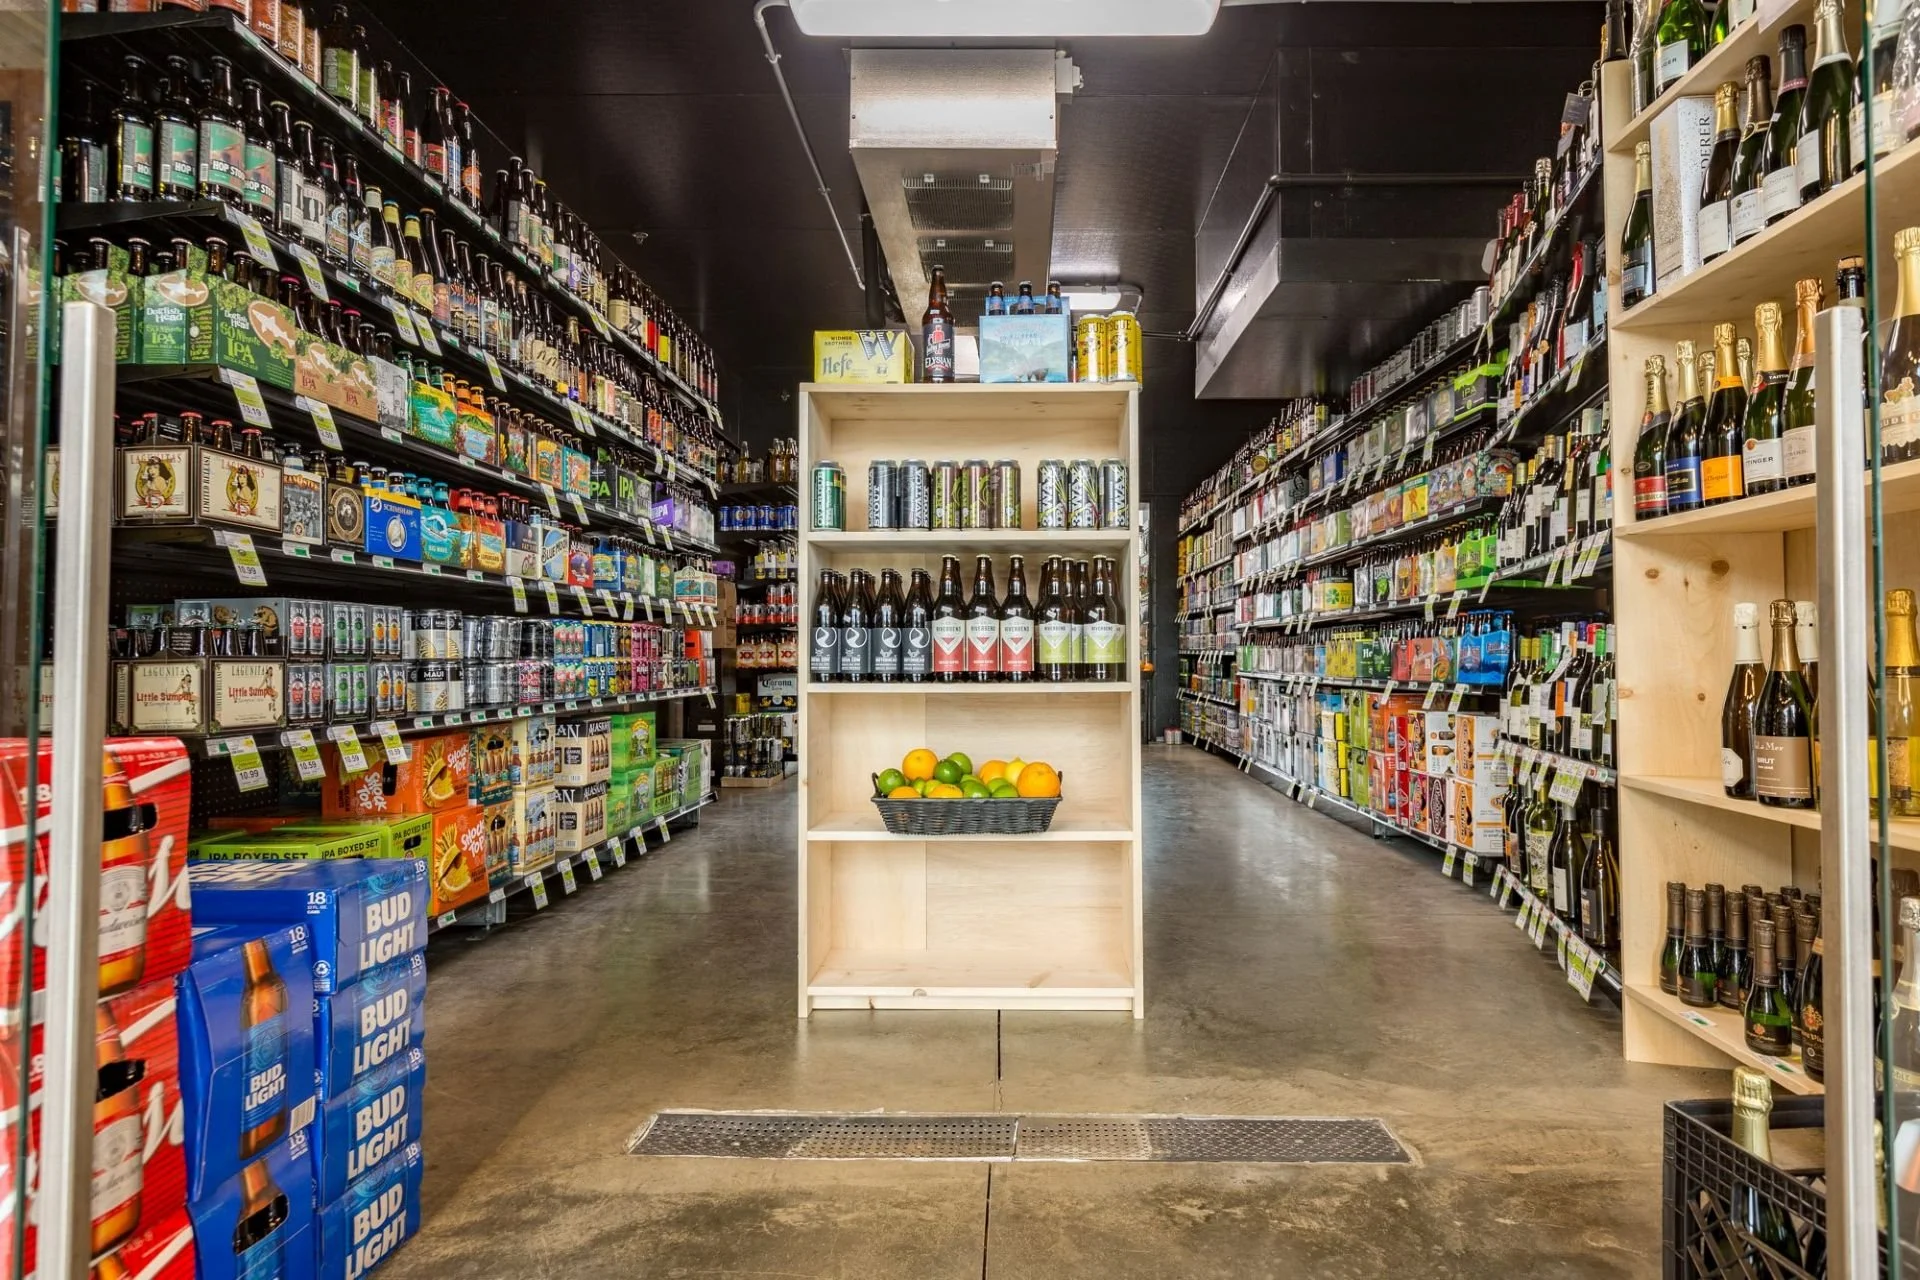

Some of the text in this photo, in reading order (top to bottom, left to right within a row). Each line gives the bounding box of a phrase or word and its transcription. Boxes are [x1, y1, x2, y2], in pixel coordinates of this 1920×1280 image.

[213, 160, 230, 172] HOP
[155, 313, 185, 323] Head
[151, 332, 177, 345] IPA
[227, 337, 256, 364] IPA
[822, 353, 853, 378] Hefe
[924, 356, 952, 369] ELYSIAN
[619, 475, 635, 500] IPA
[915, 468, 923, 527] CAVATICA
[874, 485, 883, 527] STOUT
[143, 666, 191, 678] LAGUNITAS
[228, 686, 248, 698] Little
[762, 678, 792, 689] Corona
[136, 692, 159, 702] Little
[299, 761, 317, 770] 10.59
[447, 743, 469, 766] SHOCK
[239, 769, 259, 780] 10.99
[356, 782, 373, 810] TOP
[364, 772, 387, 812] SHOCK
[337, 841, 364, 857] BOXED
[365, 838, 380, 850] SET
[414, 860, 427, 873] 18
[306, 891, 327, 906] 18
[366, 891, 412, 935] BUD
[287, 926, 306, 944] 18
[360, 921, 416, 971] LIGHT
[410, 953, 422, 969] 18
[361, 988, 408, 1038] BUD
[354, 1018, 412, 1076] LIGHT
[408, 1049, 421, 1064] 18
[249, 1063, 284, 1093] BUD
[245, 1074, 287, 1112] LIGHT
[355, 1085, 406, 1141] BUD
[289, 1130, 306, 1151] 18
[347, 1112, 409, 1181] LIGHT
[405, 1142, 419, 1160] 18
[353, 1183, 404, 1245] BUD
[345, 1210, 407, 1280] LIGHT
